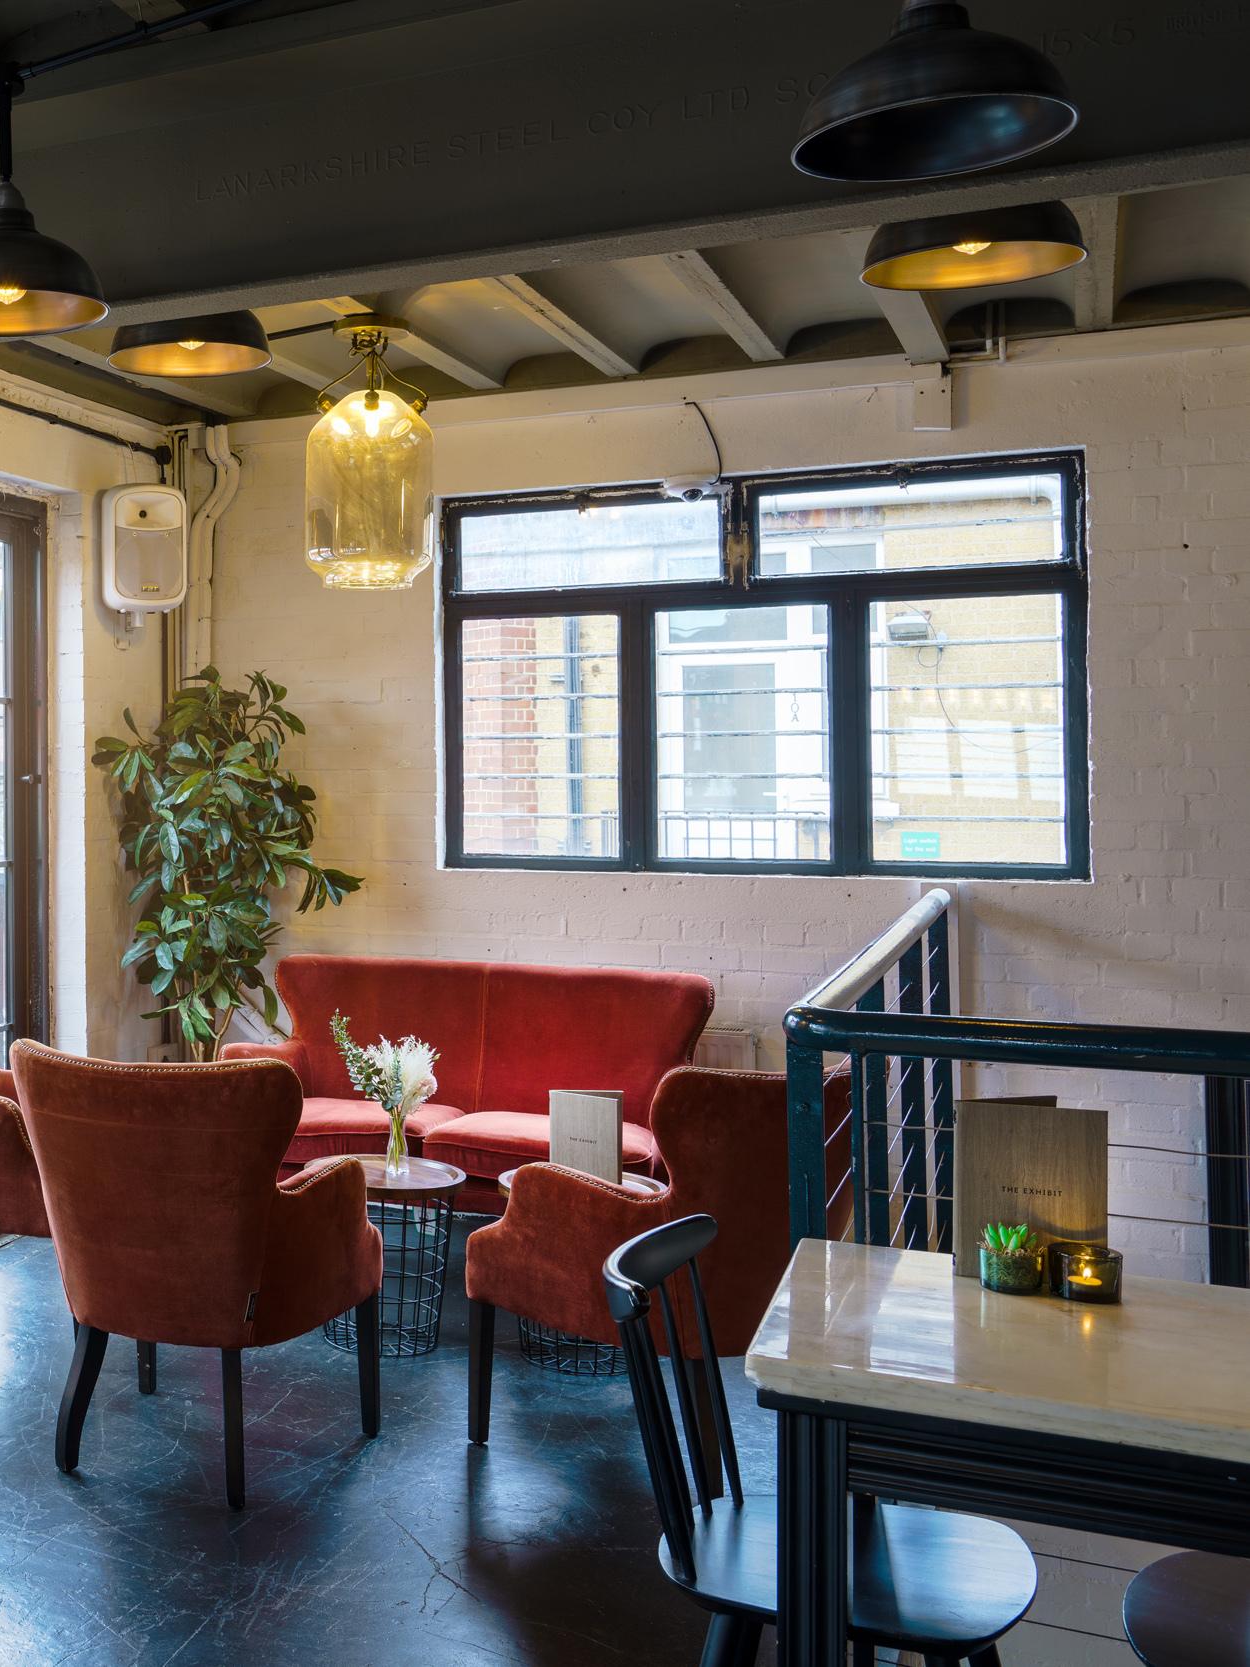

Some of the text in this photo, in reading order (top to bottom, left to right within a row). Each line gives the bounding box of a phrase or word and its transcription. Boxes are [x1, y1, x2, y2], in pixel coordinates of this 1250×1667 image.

[195, 140, 431, 202] LANARKSHIRE
[447, 119, 573, 161] STEEL
[584, 99, 662, 136] COY
[680, 85, 751, 121] LTD
[1002, 1185, 1062, 1197] THE EXHIBIT
